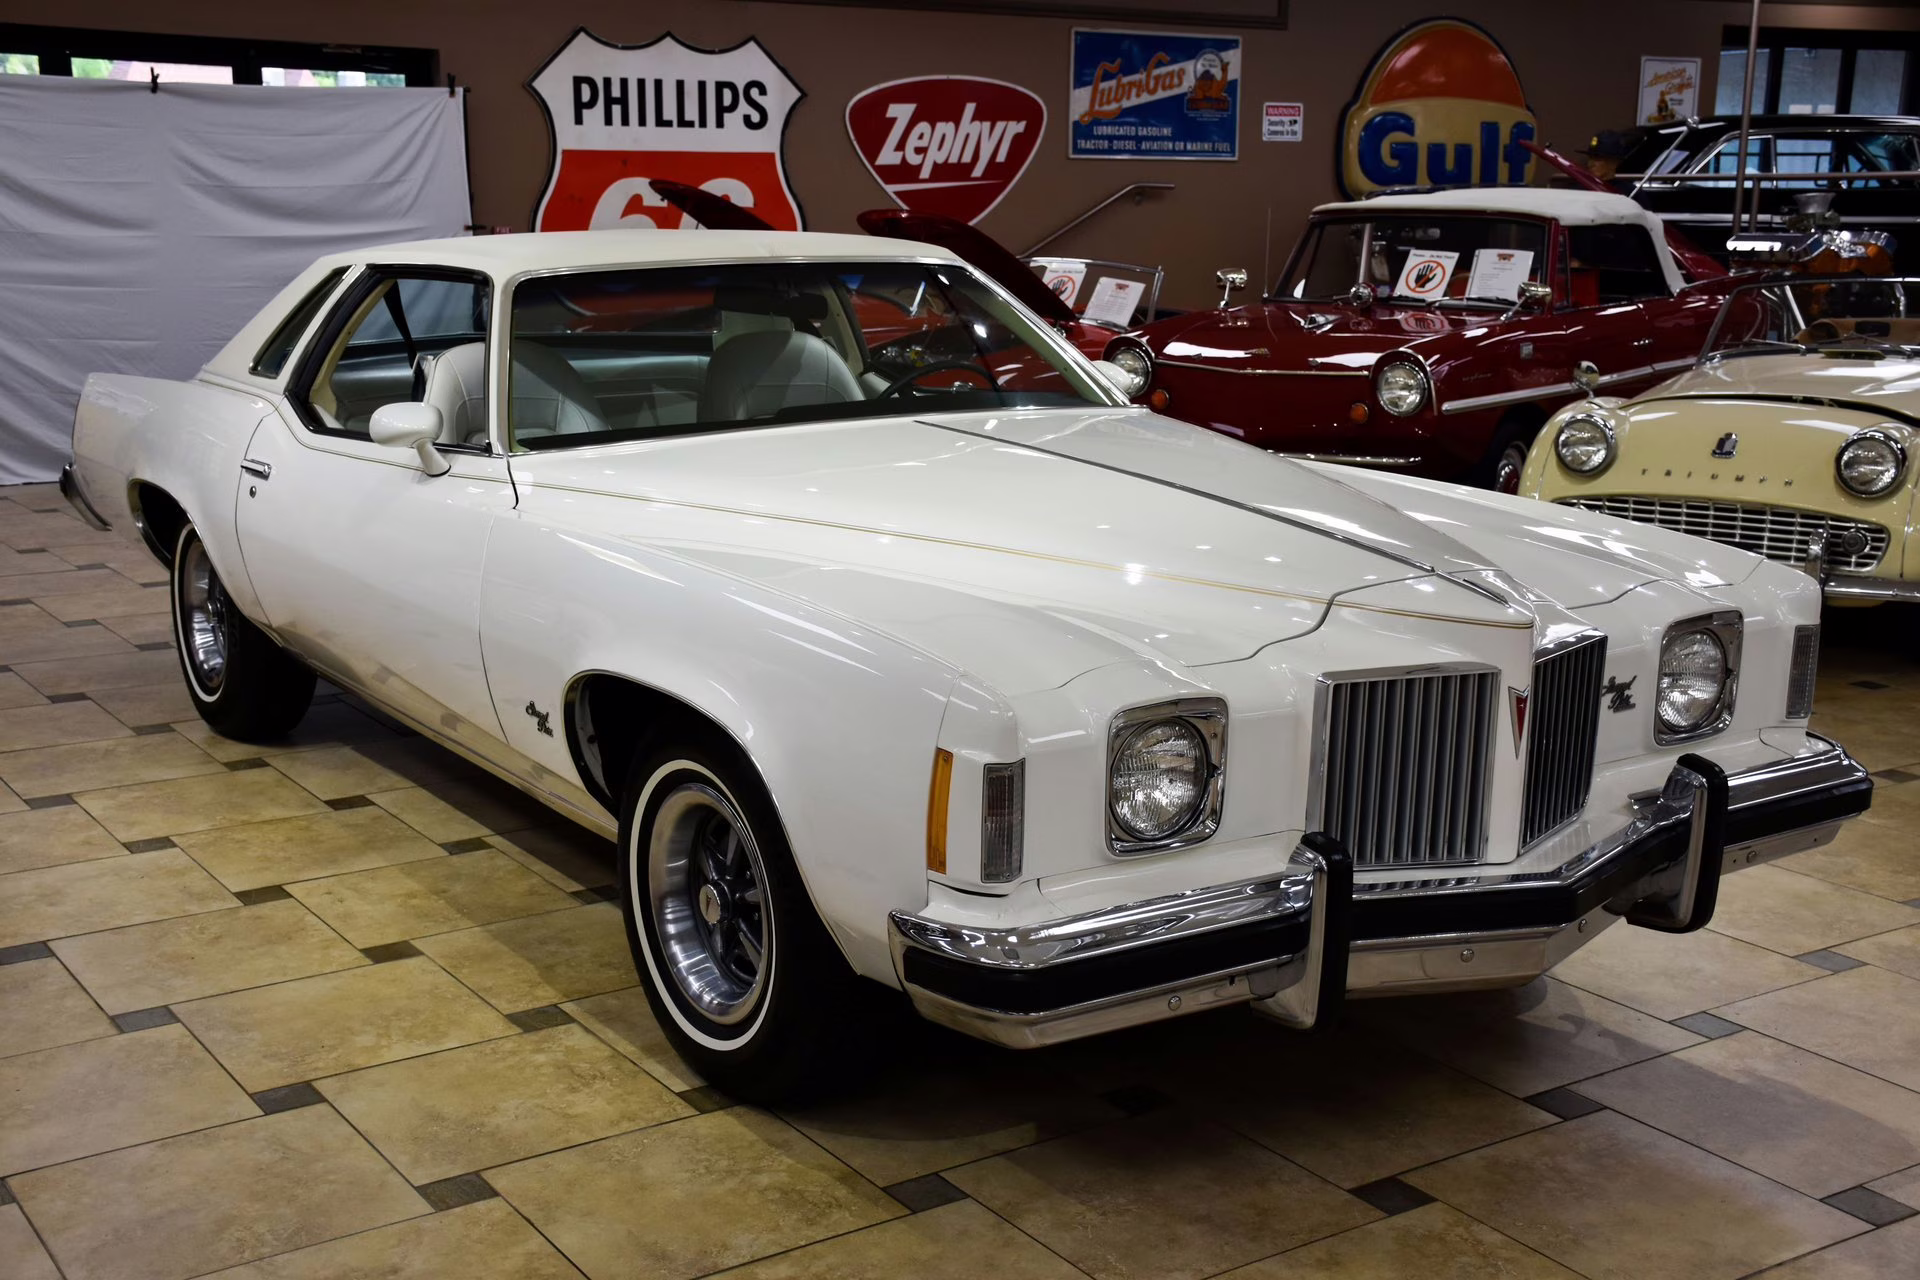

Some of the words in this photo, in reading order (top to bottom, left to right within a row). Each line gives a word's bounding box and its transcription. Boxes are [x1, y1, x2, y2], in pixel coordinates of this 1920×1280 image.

[572, 76, 769, 131] PHILLIPS
[1079, 52, 1186, 125] LubriGas
[1267, 107, 1299, 115] WARNING
[875, 102, 1027, 180] Zephyr
[1093, 125, 1136, 136] LUBRICATED
[1137, 126, 1173, 137] GASOLINE
[1174, 141, 1186, 151] OR
[1186, 141, 1213, 152] MARINE
[1214, 142, 1231, 152] FUEL
[1358, 111, 1535, 186] Gulf
[1640, 467, 1794, 487] TRIUMPH
